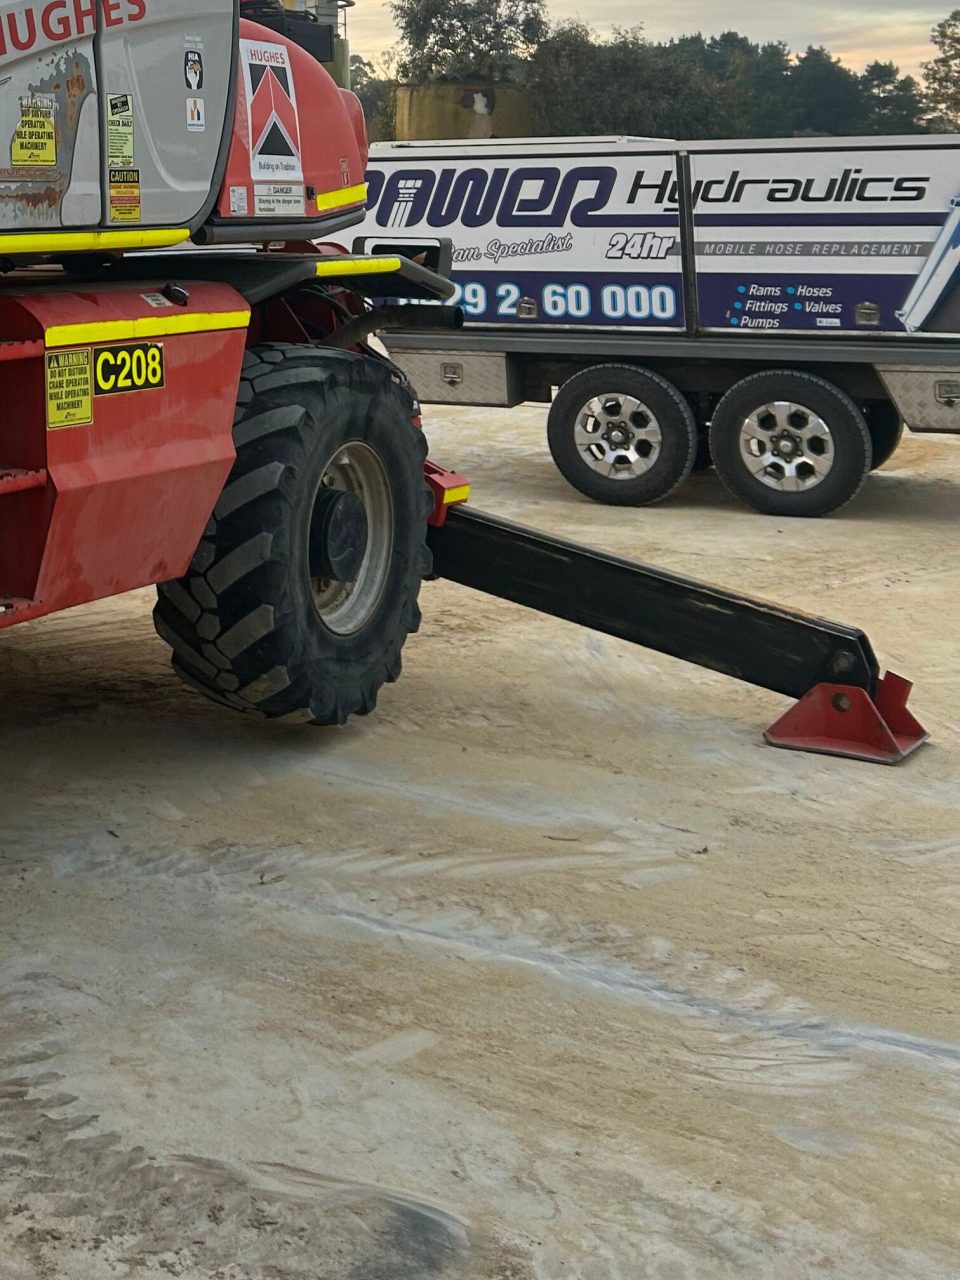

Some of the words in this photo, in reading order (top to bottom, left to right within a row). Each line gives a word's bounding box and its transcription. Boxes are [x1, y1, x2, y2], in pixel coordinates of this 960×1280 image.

[249, 49, 285, 64] HUGHES
[111, 171, 138, 182] CAUTION
[627, 169, 930, 212] Hydraulics
[451, 243, 482, 262] am
[484, 232, 573, 264] Specialist
[605, 232, 675, 259] 24hr
[703, 243, 757, 254] MOBILE
[765, 243, 804, 254] HOSE
[812, 244, 923, 255] REPLACEMENT
[749, 284, 781, 296] Rams
[797, 285, 833, 297] Hoses
[601, 284, 676, 319] 000
[745, 300, 789, 314] Fittings
[805, 301, 842, 313] Valves
[740, 316, 780, 329] Pumps
[58, 352, 88, 367] WARNING
[96, 347, 162, 391] C208
